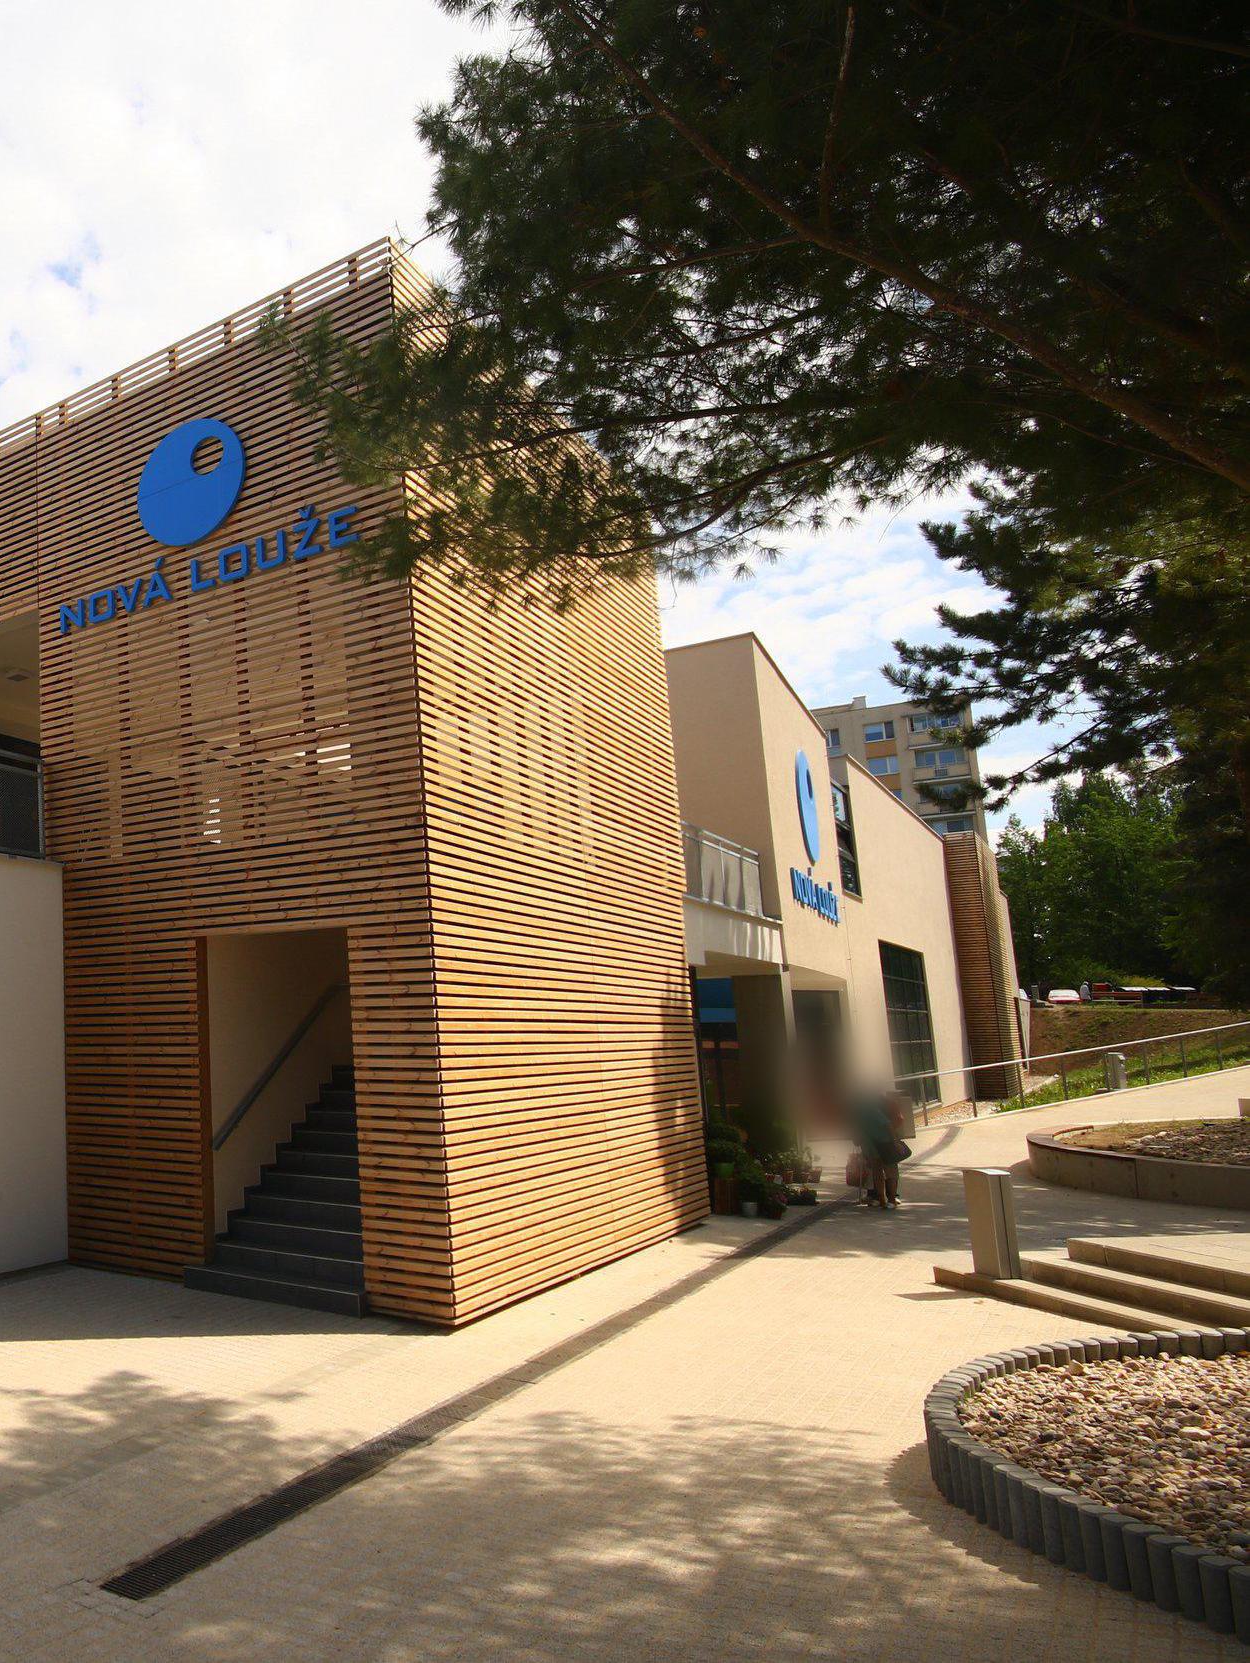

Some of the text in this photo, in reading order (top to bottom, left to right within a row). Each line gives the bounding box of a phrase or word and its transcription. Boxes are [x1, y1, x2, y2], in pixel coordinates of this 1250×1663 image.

[59, 504, 360, 634] NOVÁ LOUŽE
[790, 867, 817, 910] NOVÁ
